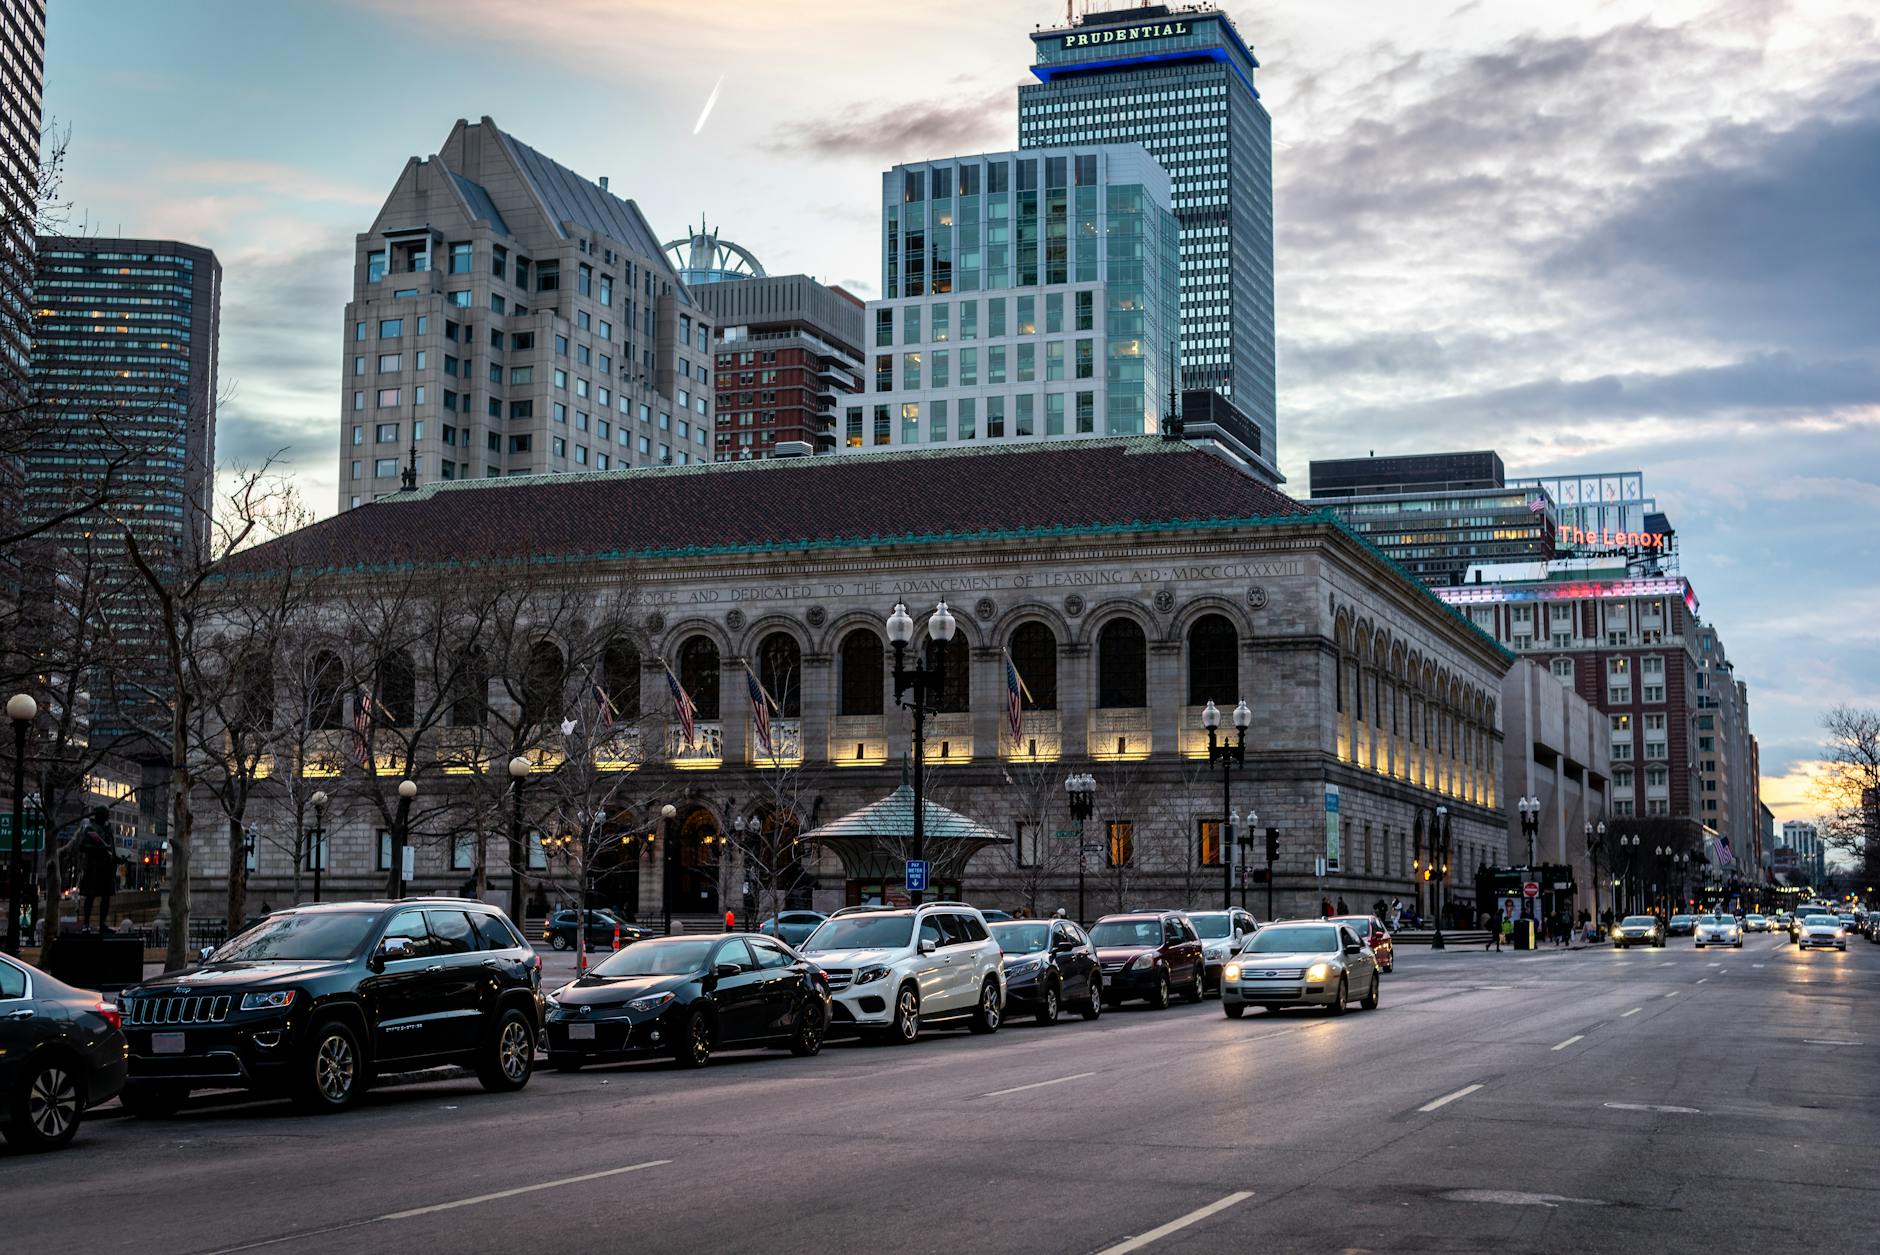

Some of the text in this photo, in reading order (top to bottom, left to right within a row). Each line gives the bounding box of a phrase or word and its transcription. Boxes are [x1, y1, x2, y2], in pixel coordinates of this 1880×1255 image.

[1065, 23, 1187, 47] PRUDENTIAL
[1558, 525, 1664, 547] The Lenox
[689, 590, 719, 604] AND
[731, 586, 811, 601] DEDICATED
[824, 583, 844, 596] TO
[854, 582, 883, 595] THE
[892, 577, 1002, 593] ADVANCEMENT
[1013, 575, 1035, 588] OF
[1045, 571, 1123, 586] LEARNING
